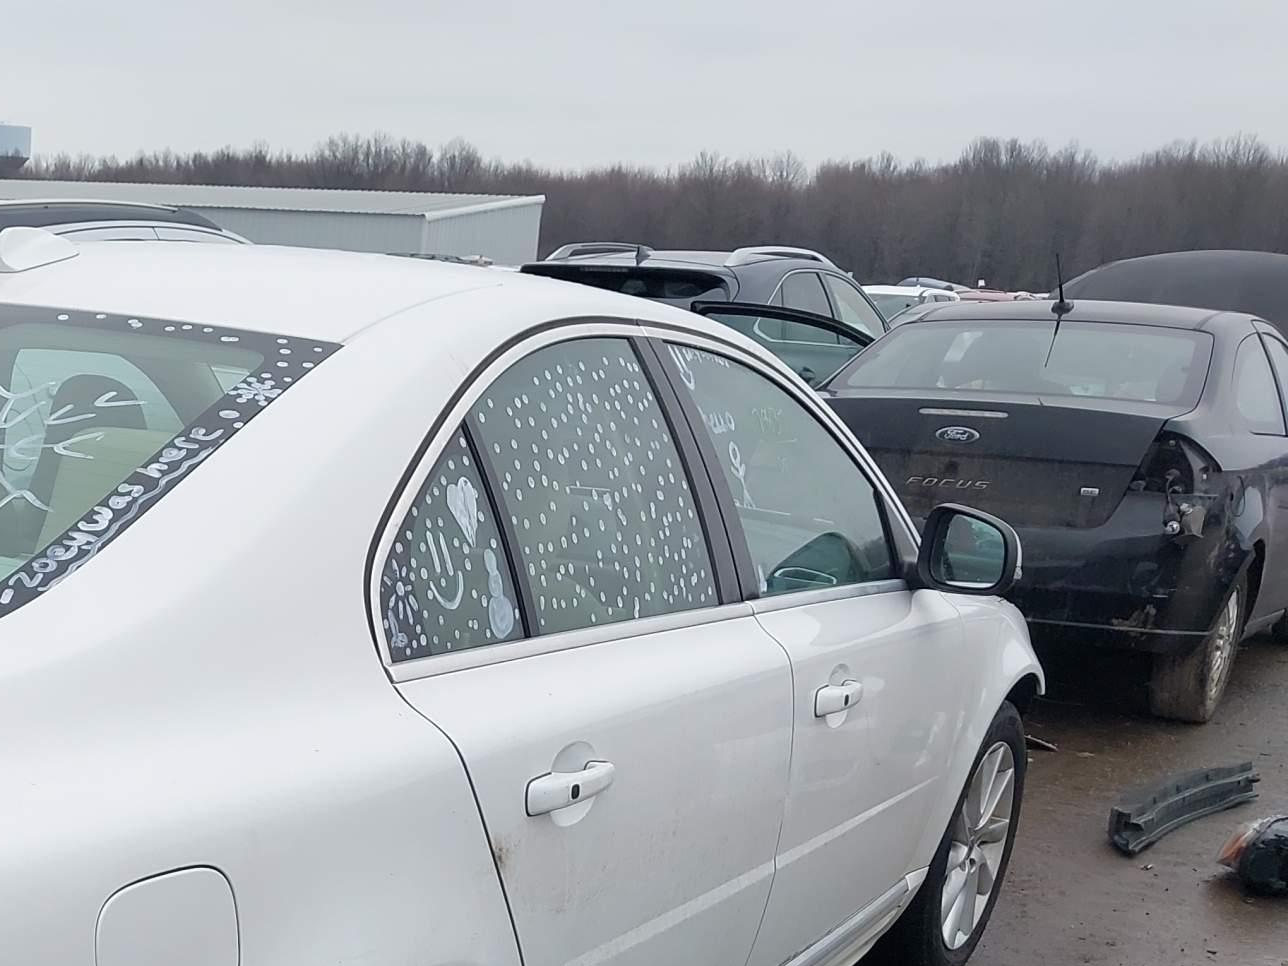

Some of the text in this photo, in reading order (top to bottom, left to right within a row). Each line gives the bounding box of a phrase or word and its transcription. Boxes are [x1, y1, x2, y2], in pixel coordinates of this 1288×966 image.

[78, 483, 145, 530] was
[136, 426, 225, 479] here
[905, 476, 991, 490] FOCUS
